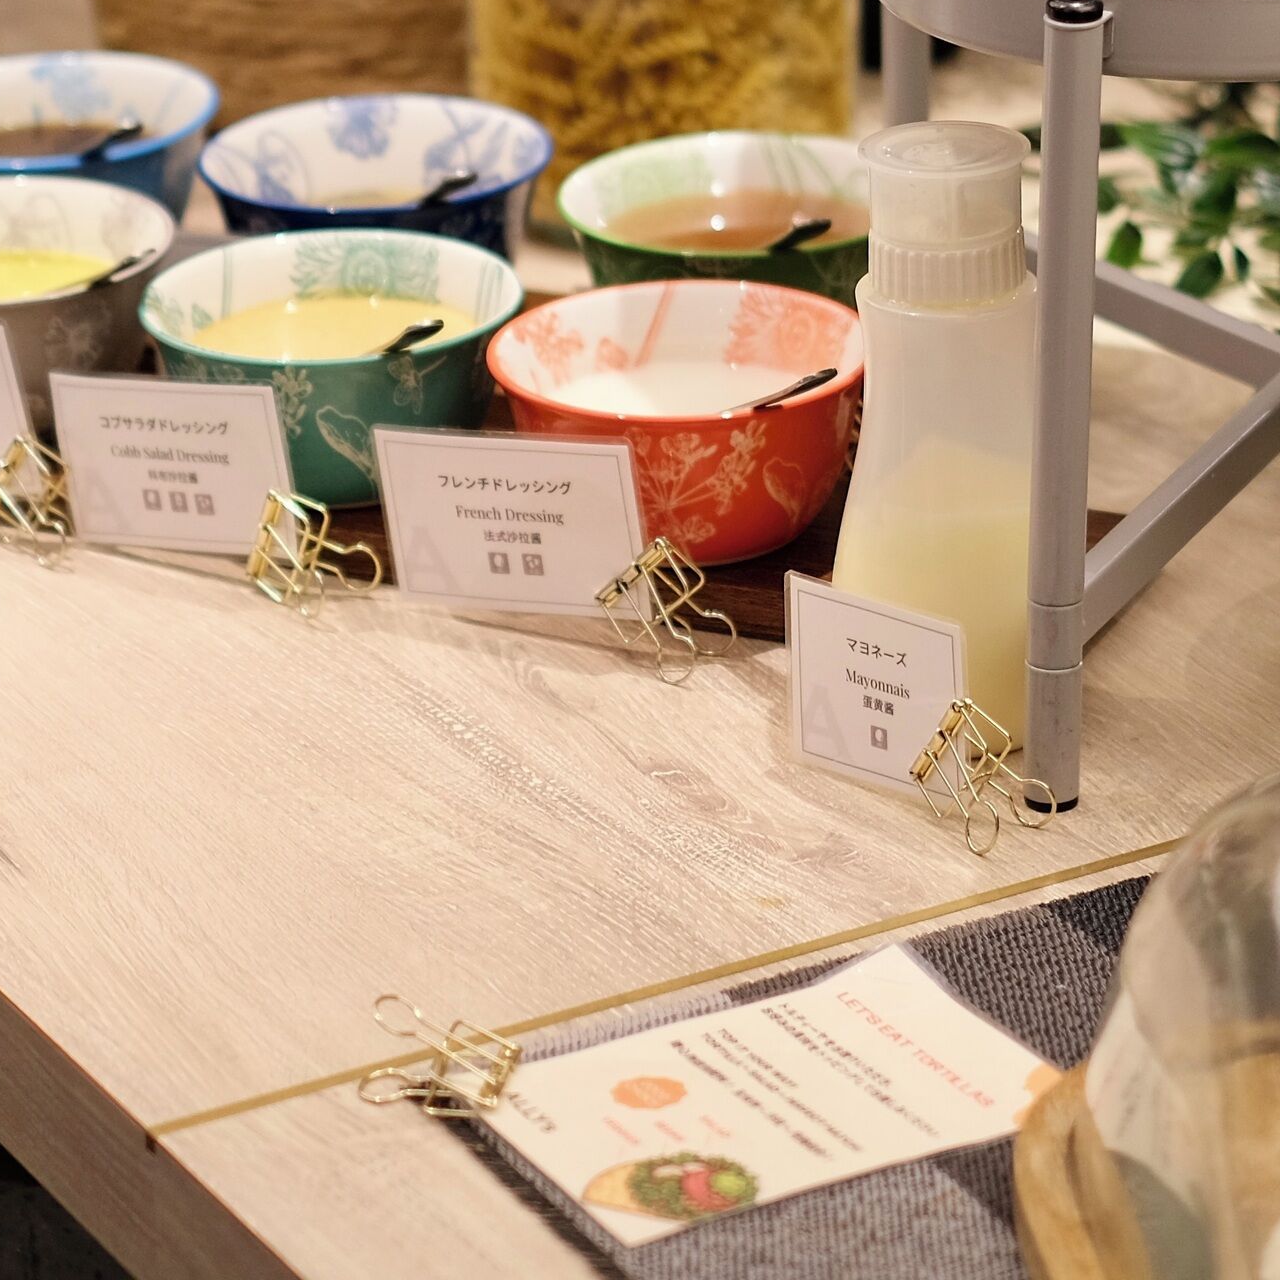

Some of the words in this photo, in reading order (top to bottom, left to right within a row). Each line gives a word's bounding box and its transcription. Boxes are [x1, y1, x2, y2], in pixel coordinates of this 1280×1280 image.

[98, 416, 229, 435] コブサラダドレッシング
[110, 443, 142, 458] Cobb
[143, 446, 175, 461] Salad
[176, 449, 231, 466] Dressing
[437, 474, 571, 495] フレンチドレッシング
[455, 504, 502, 521] French
[505, 507, 565, 526] Dressing
[846, 637, 907, 668] マヨネーズ
[845, 667, 911, 700] Mayonnais
[877, 1023, 914, 1049] EAT
[913, 1048, 997, 1109] TORTILLAS
